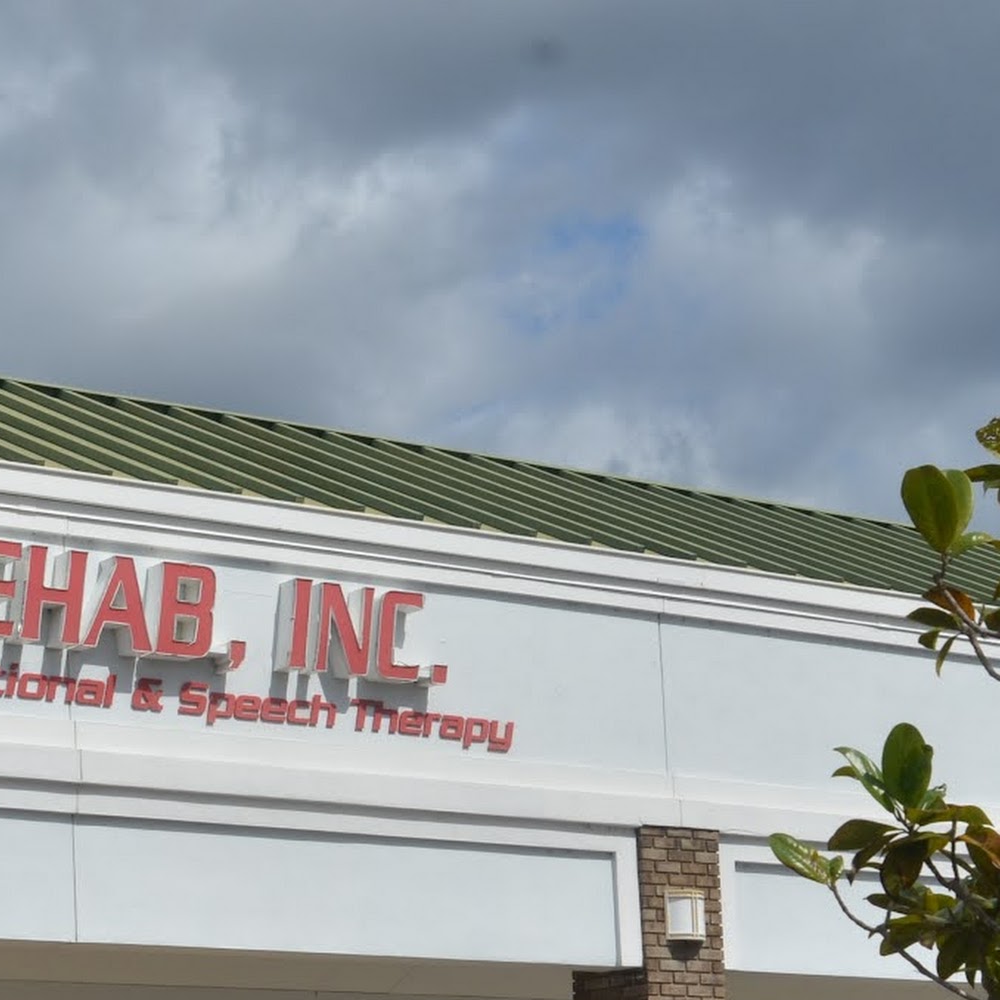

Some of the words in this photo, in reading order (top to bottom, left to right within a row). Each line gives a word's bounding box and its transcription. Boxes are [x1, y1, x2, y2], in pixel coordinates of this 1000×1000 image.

[286, 577, 448, 686] INC.
[131, 677, 165, 712] &
[178, 681, 337, 728] Speech
[350, 698, 515, 753] Therapy
